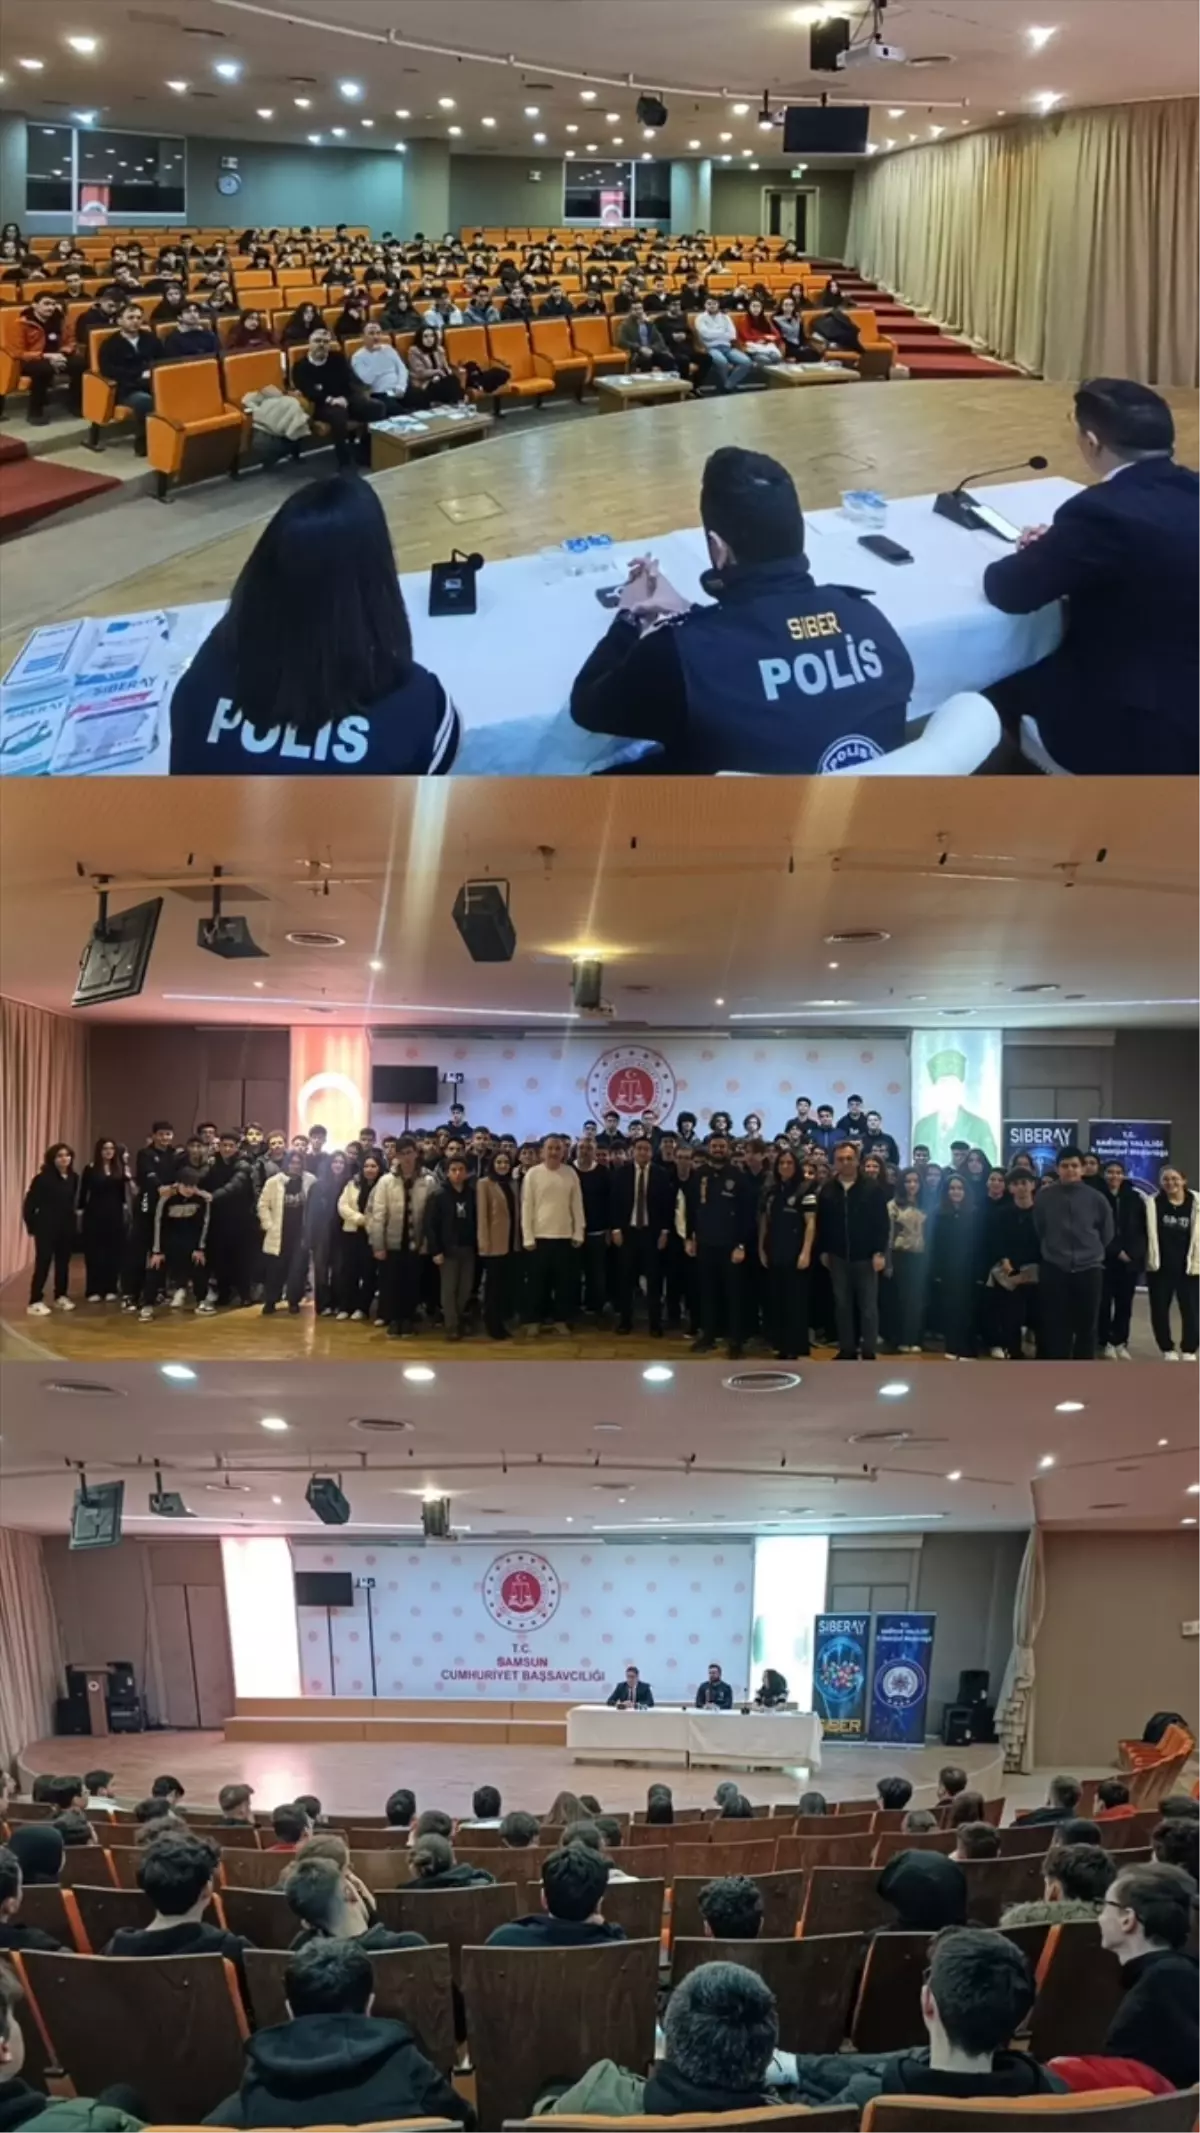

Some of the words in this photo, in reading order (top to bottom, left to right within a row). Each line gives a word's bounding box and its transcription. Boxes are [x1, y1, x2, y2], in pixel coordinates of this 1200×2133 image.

[758, 633, 883, 701] POLİS
[496, 1656, 549, 1668] SAMSUN
[440, 1669, 519, 1681] CUMHURİYET
